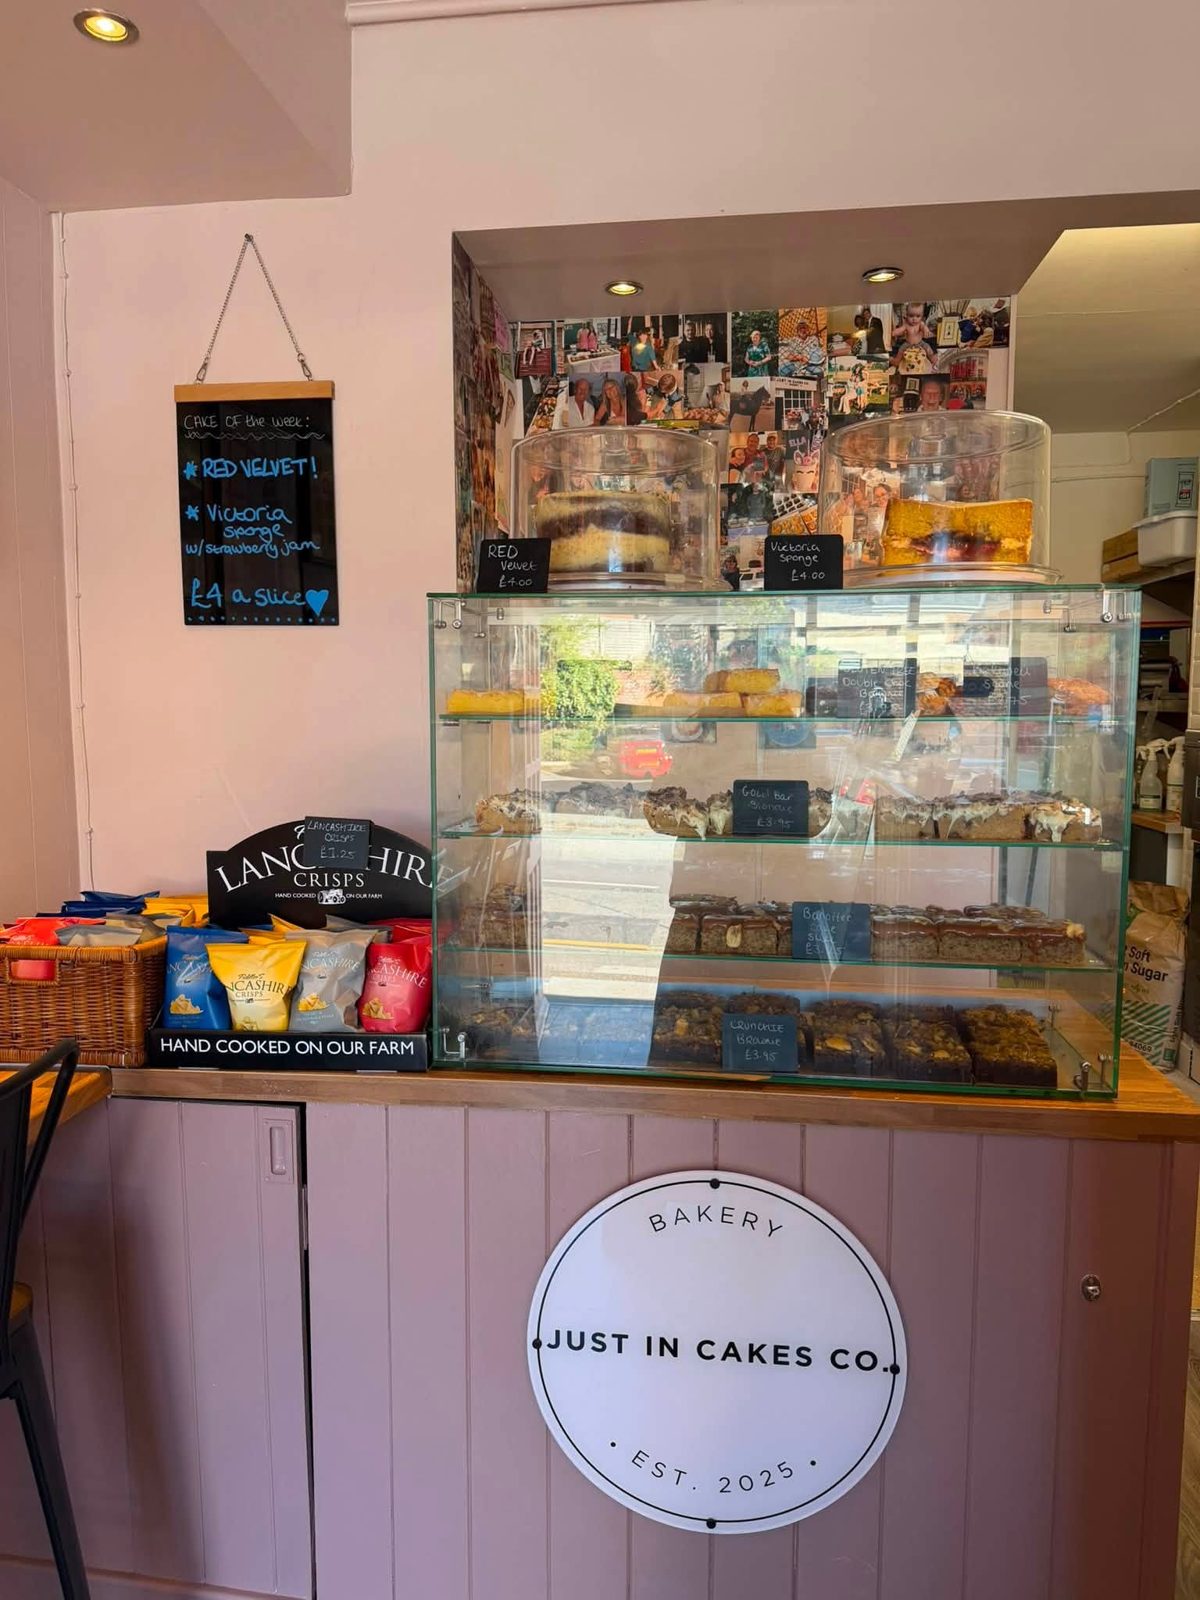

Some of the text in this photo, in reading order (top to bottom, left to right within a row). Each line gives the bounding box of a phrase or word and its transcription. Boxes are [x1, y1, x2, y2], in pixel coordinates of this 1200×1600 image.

[184, 414, 218, 429] CAKE
[225, 414, 243, 428] OF
[245, 413, 266, 428] the
[202, 457, 238, 478] RED
[206, 504, 294, 524] Victoria
[223, 524, 285, 543] sponge
[280, 538, 321, 558] jam
[487, 543, 519, 559] RED
[770, 541, 821, 552] Victoria
[190, 577, 225, 608] £4
[232, 587, 252, 605] a
[293, 872, 366, 888] CRISPS
[1128, 945, 1151, 963] Soft
[1130, 961, 1169, 982] Sugar
[160, 1038, 415, 1055] HAND COOKED ON OUR FARM
[744, 1049, 779, 1062] £3.95
[648, 1204, 784, 1239] BAKERY
[546, 1329, 890, 1373] JUST IN CAKES CO.
[631, 1449, 794, 1494] EST. 2025
